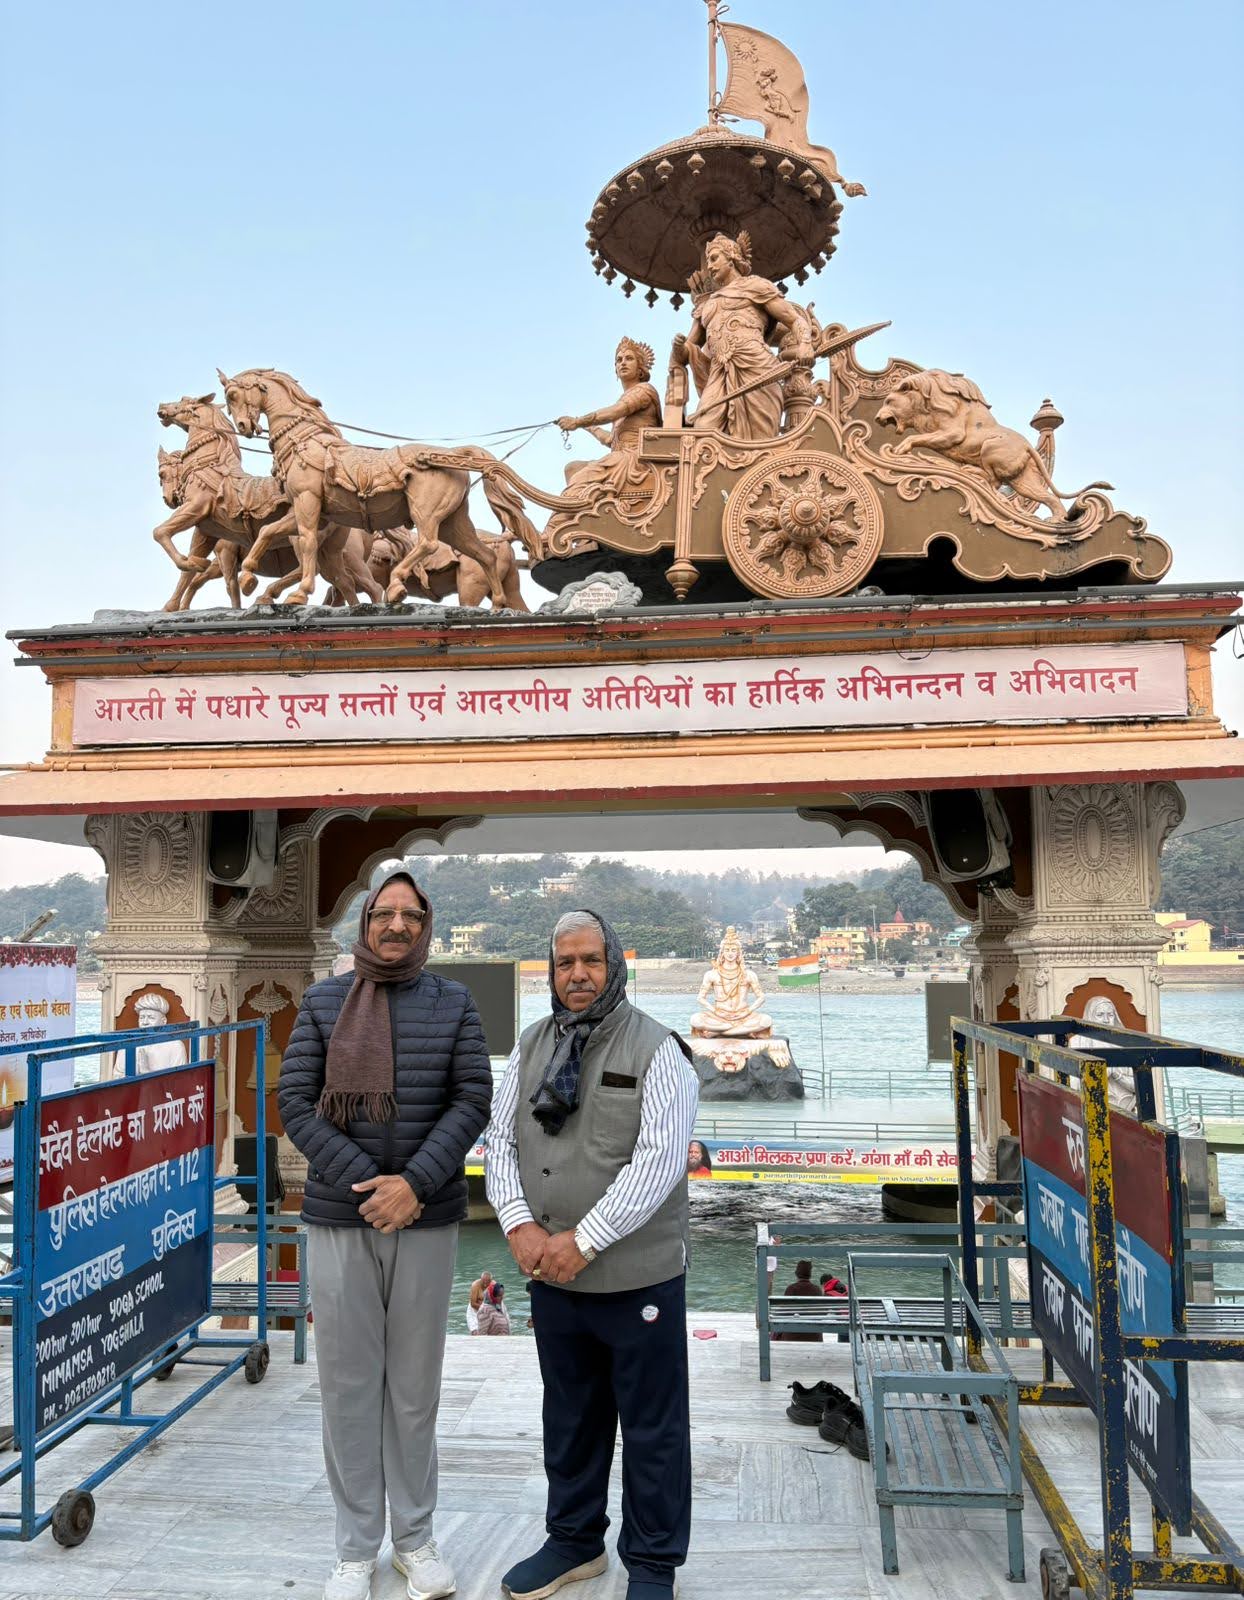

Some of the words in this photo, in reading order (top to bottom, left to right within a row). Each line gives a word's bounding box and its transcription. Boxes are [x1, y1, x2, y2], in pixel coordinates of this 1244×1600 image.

[94, 687, 166, 722] आरती
[175, 688, 197, 721] में
[206, 687, 270, 720] पधारे
[279, 692, 330, 729] पूज्य
[339, 683, 398, 718] सन्तों
[408, 684, 446, 721] एवं
[456, 678, 572, 716] आदरणीय
[582, 675, 693, 711] अतिथियों
[703, 682, 737, 708] का
[746, 668, 825, 710] हार्दिक
[836, 665, 964, 702] अभिनन्दन
[975, 671, 997, 697] व
[1009, 658, 1138, 695] अभिवादन
[10, 1000, 22, 1019] एवं
[77, 1108, 123, 1161] हेलमेट
[127, 1109, 146, 1143] का
[153, 1092, 185, 1135] प्रयोग
[187, 1085, 205, 1124] करें
[717, 1146, 750, 1164] आओ
[754, 1145, 803, 1164] मिलकर
[805, 1151, 826, 1167] प्रण
[831, 1148, 857, 1166] करें,
[861, 1149, 891, 1166] गंगा
[894, 1149, 912, 1166] माँ
[914, 1149, 933, 1166] की
[48, 1185, 99, 1251] पुलिस
[179, 1147, 199, 1187] 112
[37, 1244, 125, 1318] उत्तराखण्ड
[152, 1208, 196, 1262] पुलिस
[110, 1291, 134, 1322] YOGA
[135, 1271, 164, 1305] SCHOOL
[41, 1345, 93, 1398] MIMAMSA
[101, 1312, 145, 1356] YOGSHALA
